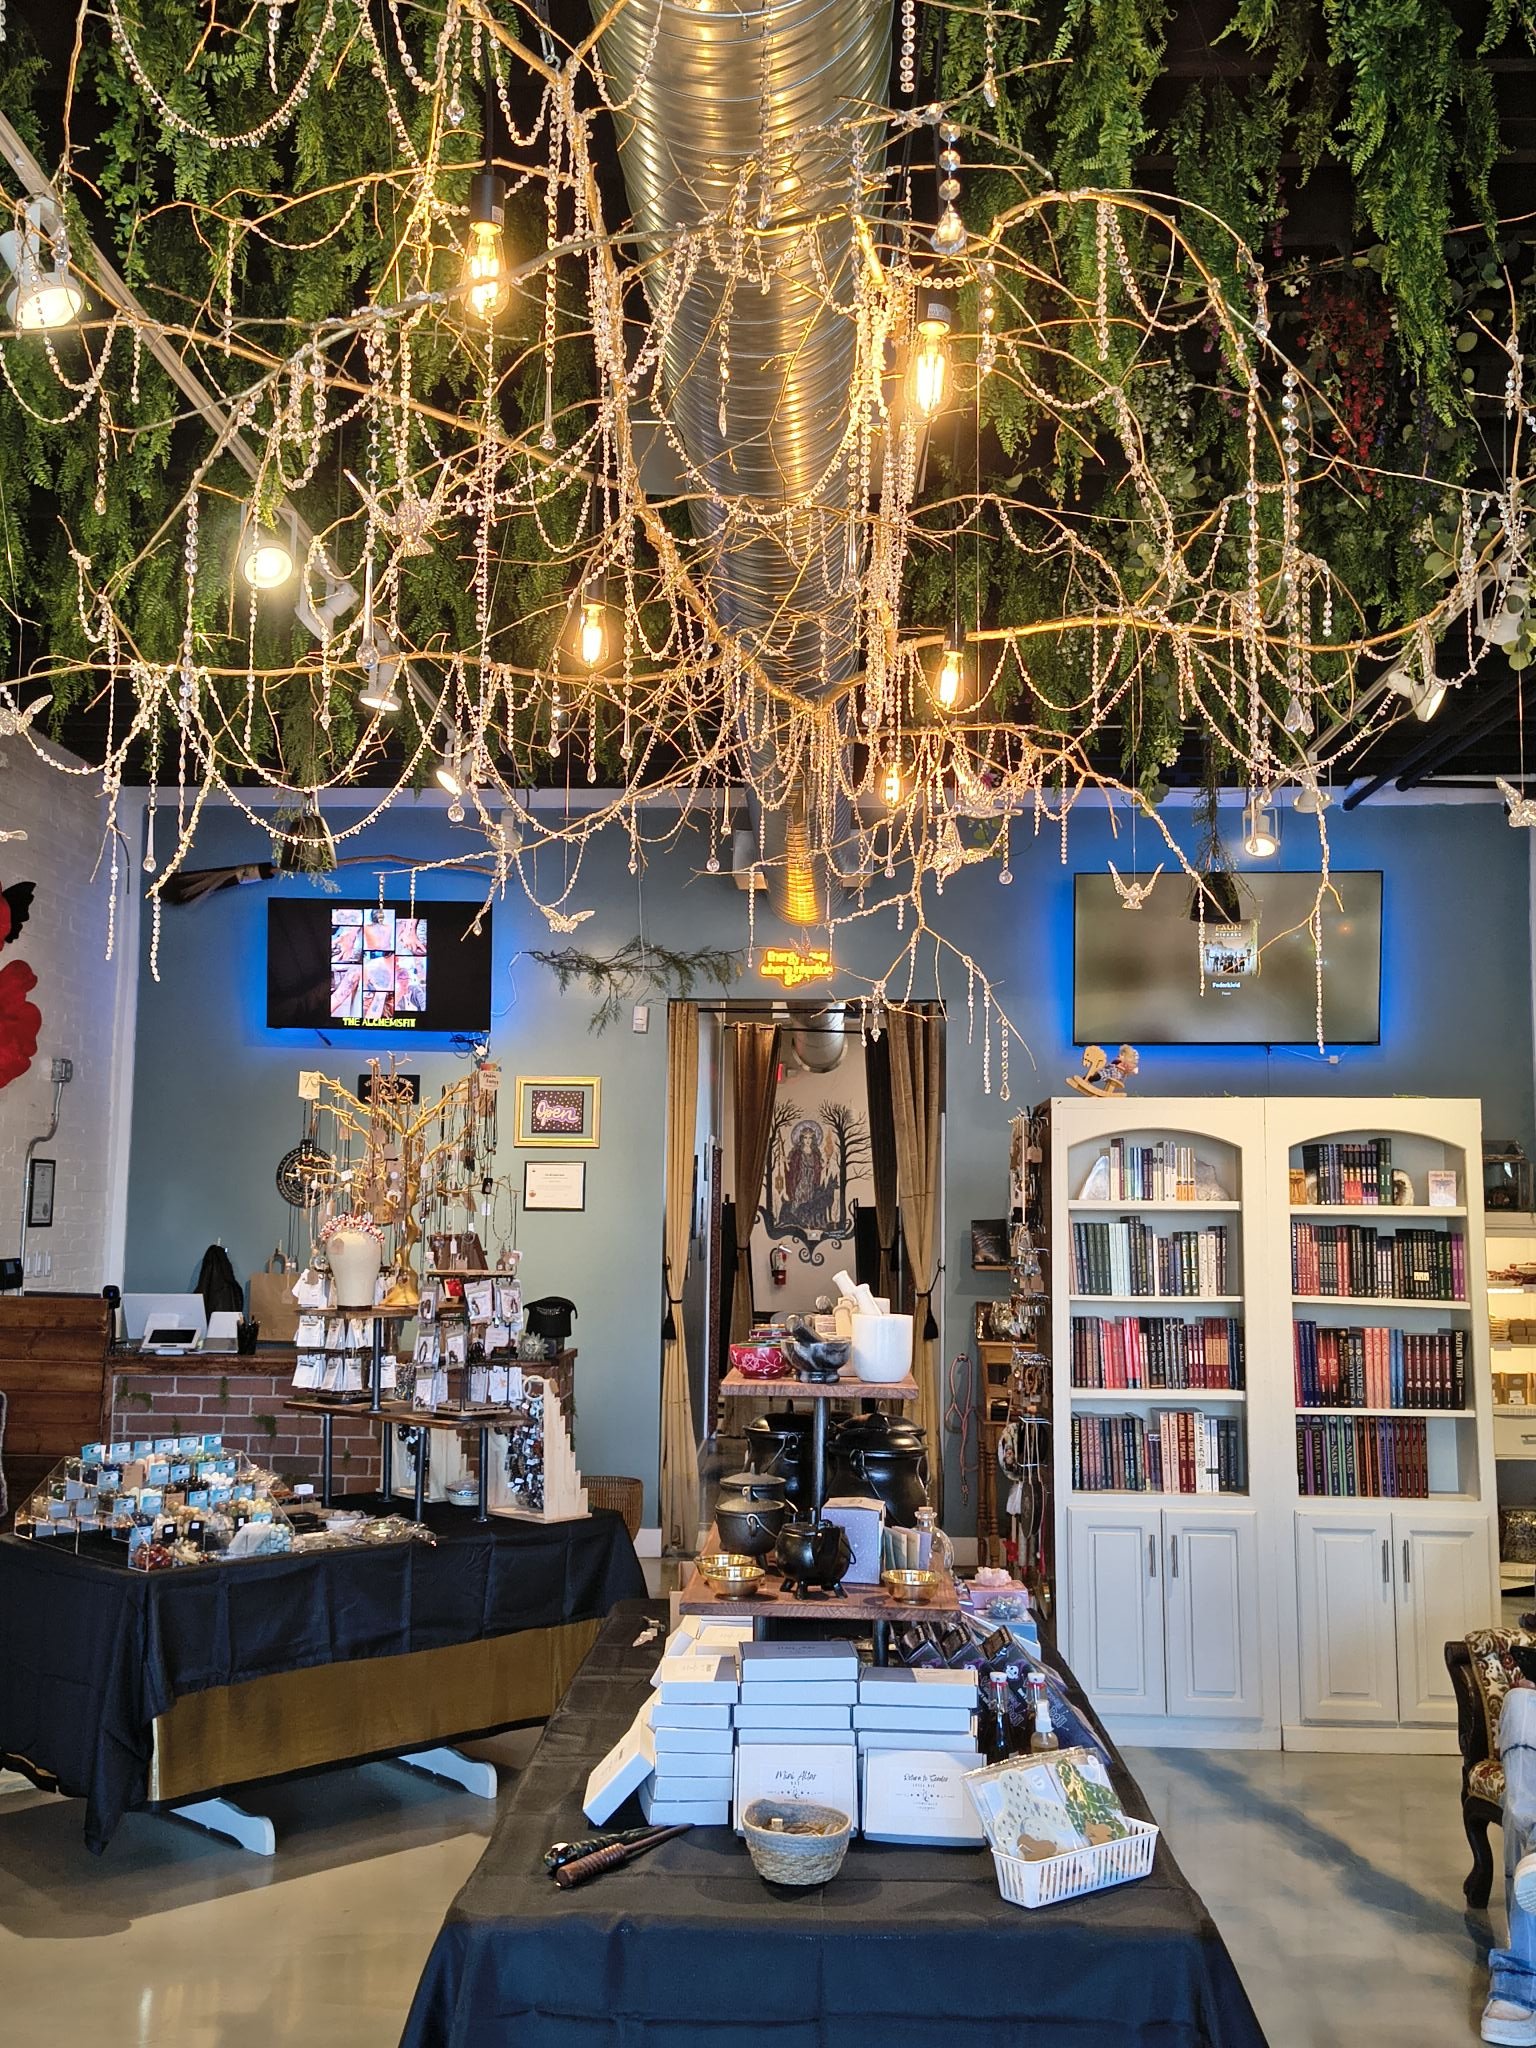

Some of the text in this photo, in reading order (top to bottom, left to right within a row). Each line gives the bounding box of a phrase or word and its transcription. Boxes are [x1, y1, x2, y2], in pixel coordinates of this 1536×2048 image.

[342, 1017, 361, 1026] THE
[535, 1100, 579, 1127] Open
[1455, 1331, 1464, 1378] SOLITARY WITCH
